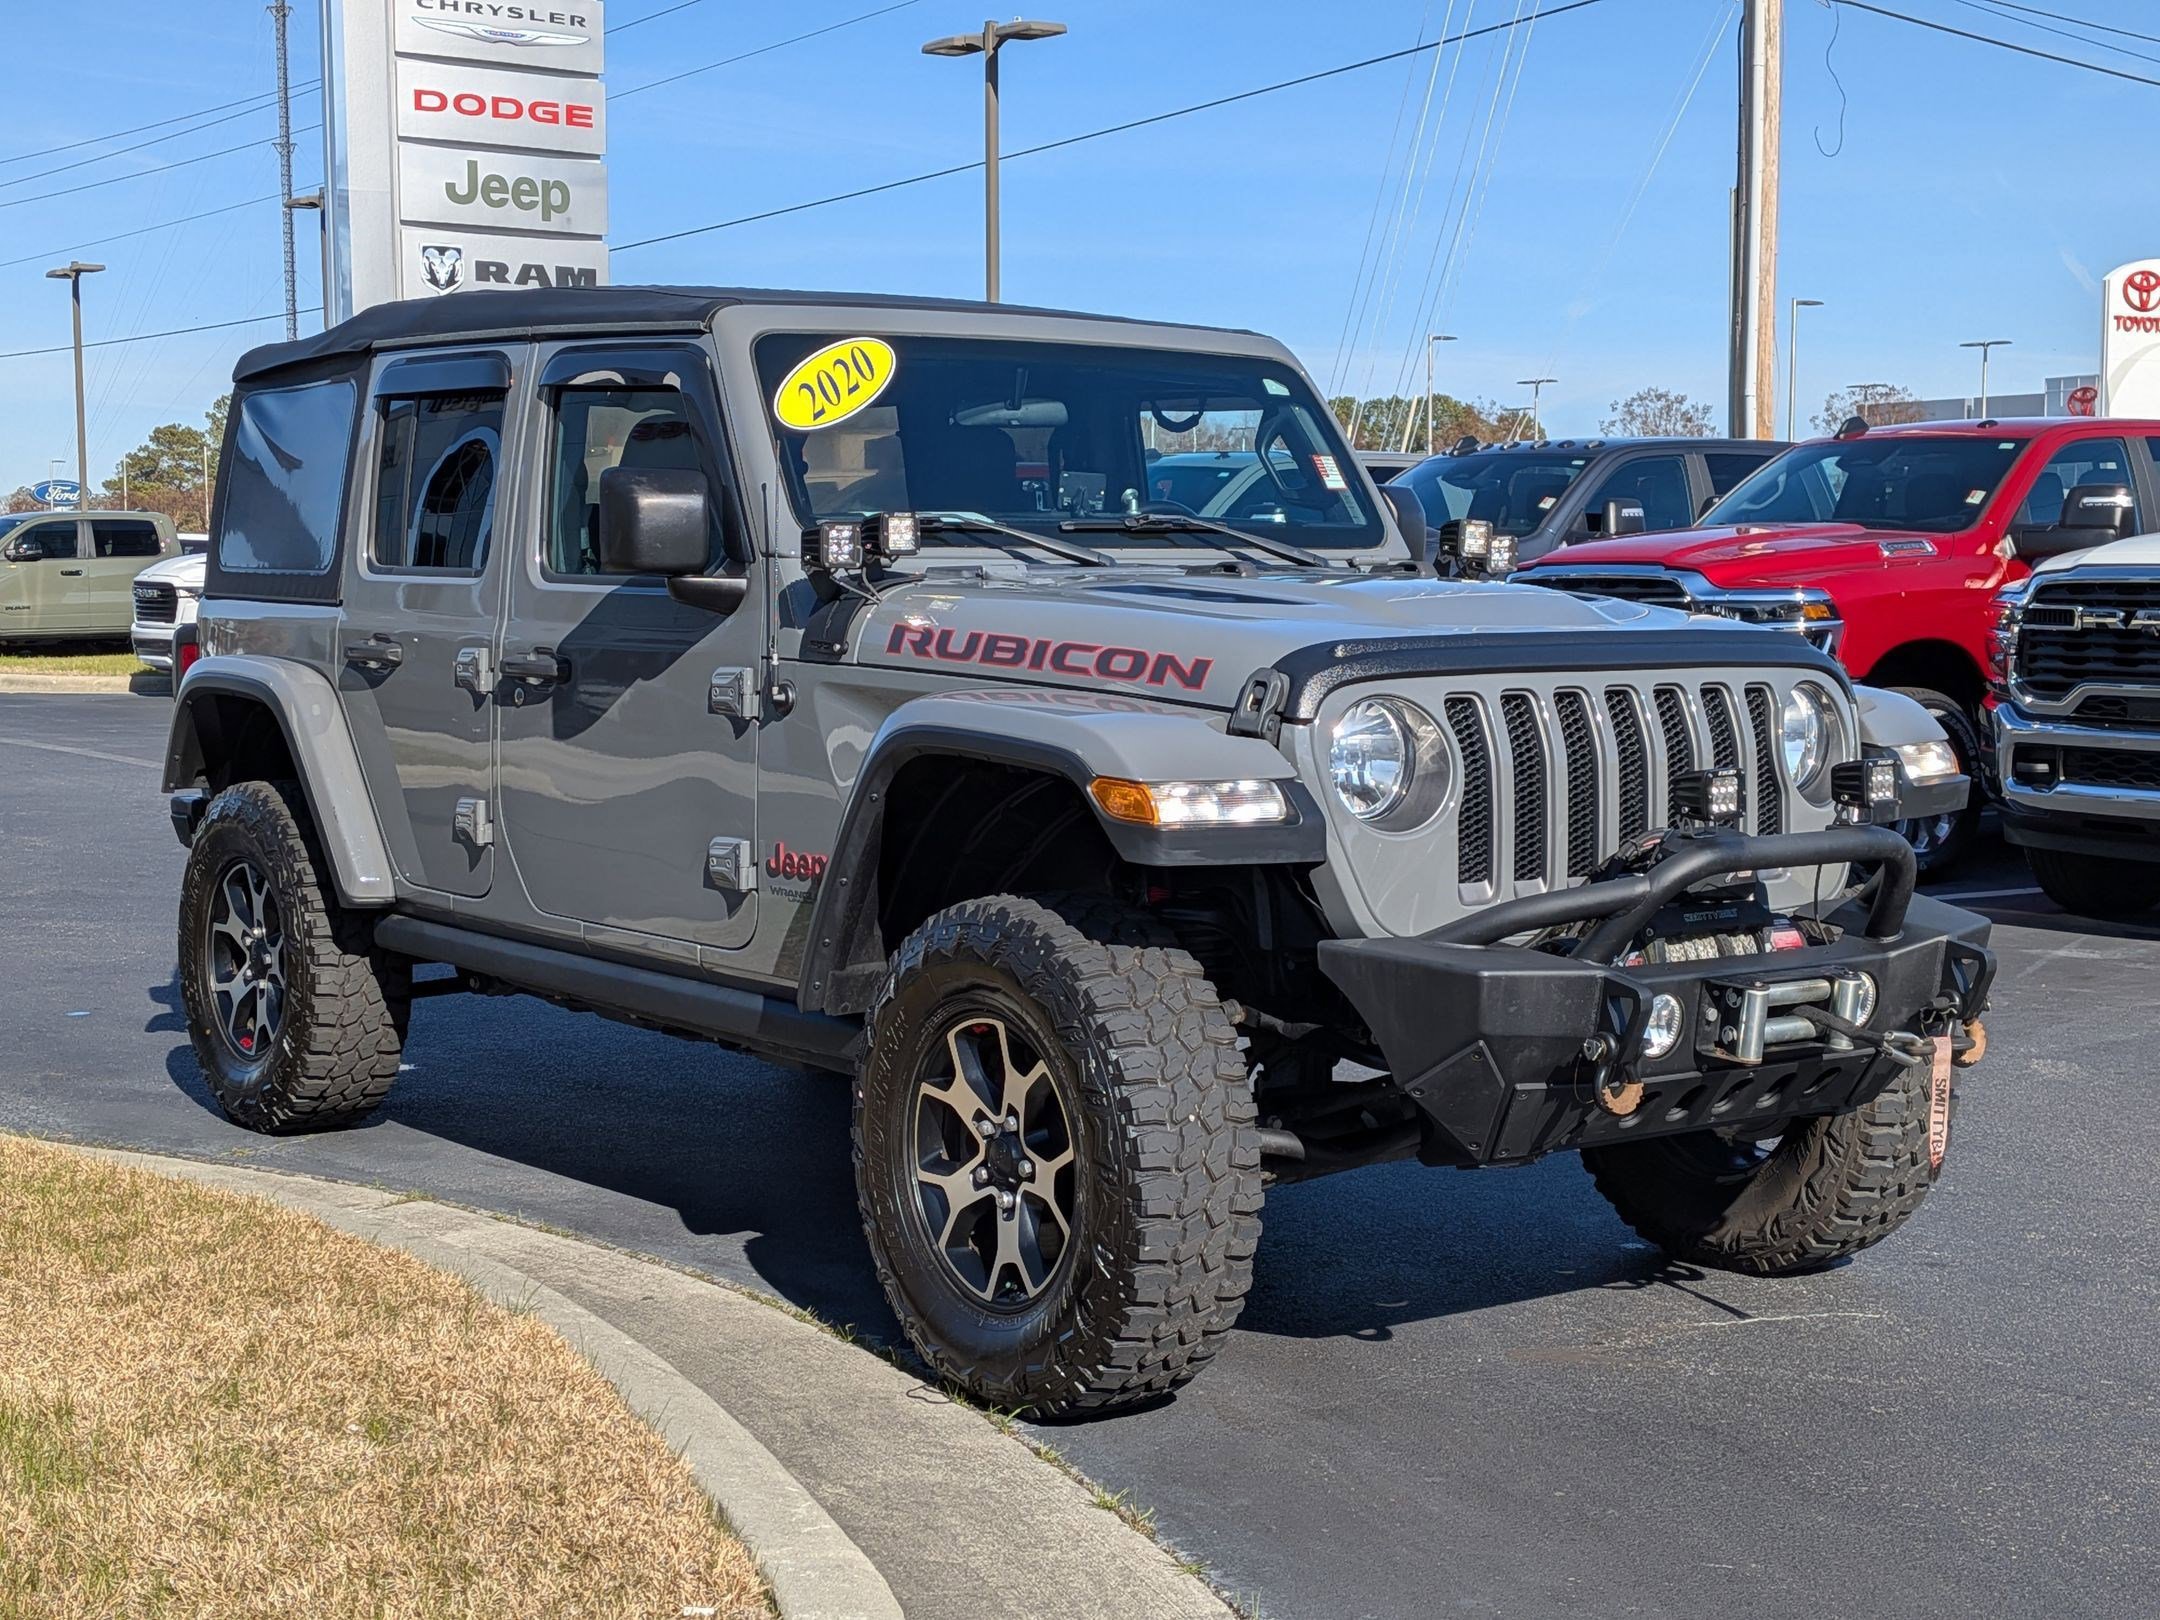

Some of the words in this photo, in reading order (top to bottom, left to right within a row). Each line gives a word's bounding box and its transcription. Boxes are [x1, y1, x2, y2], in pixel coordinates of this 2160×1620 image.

[416, 0, 587, 28] CHRYSLER
[413, 89, 594, 129] DODGE
[445, 159, 571, 222] Jeep
[474, 260, 597, 288] RAM
[2113, 315, 2160, 333] TOYOT
[798, 346, 875, 421] 2020
[45, 486, 80, 501] Ford
[885, 623, 1215, 691] RUBICON
[765, 842, 829, 887] Jeep
